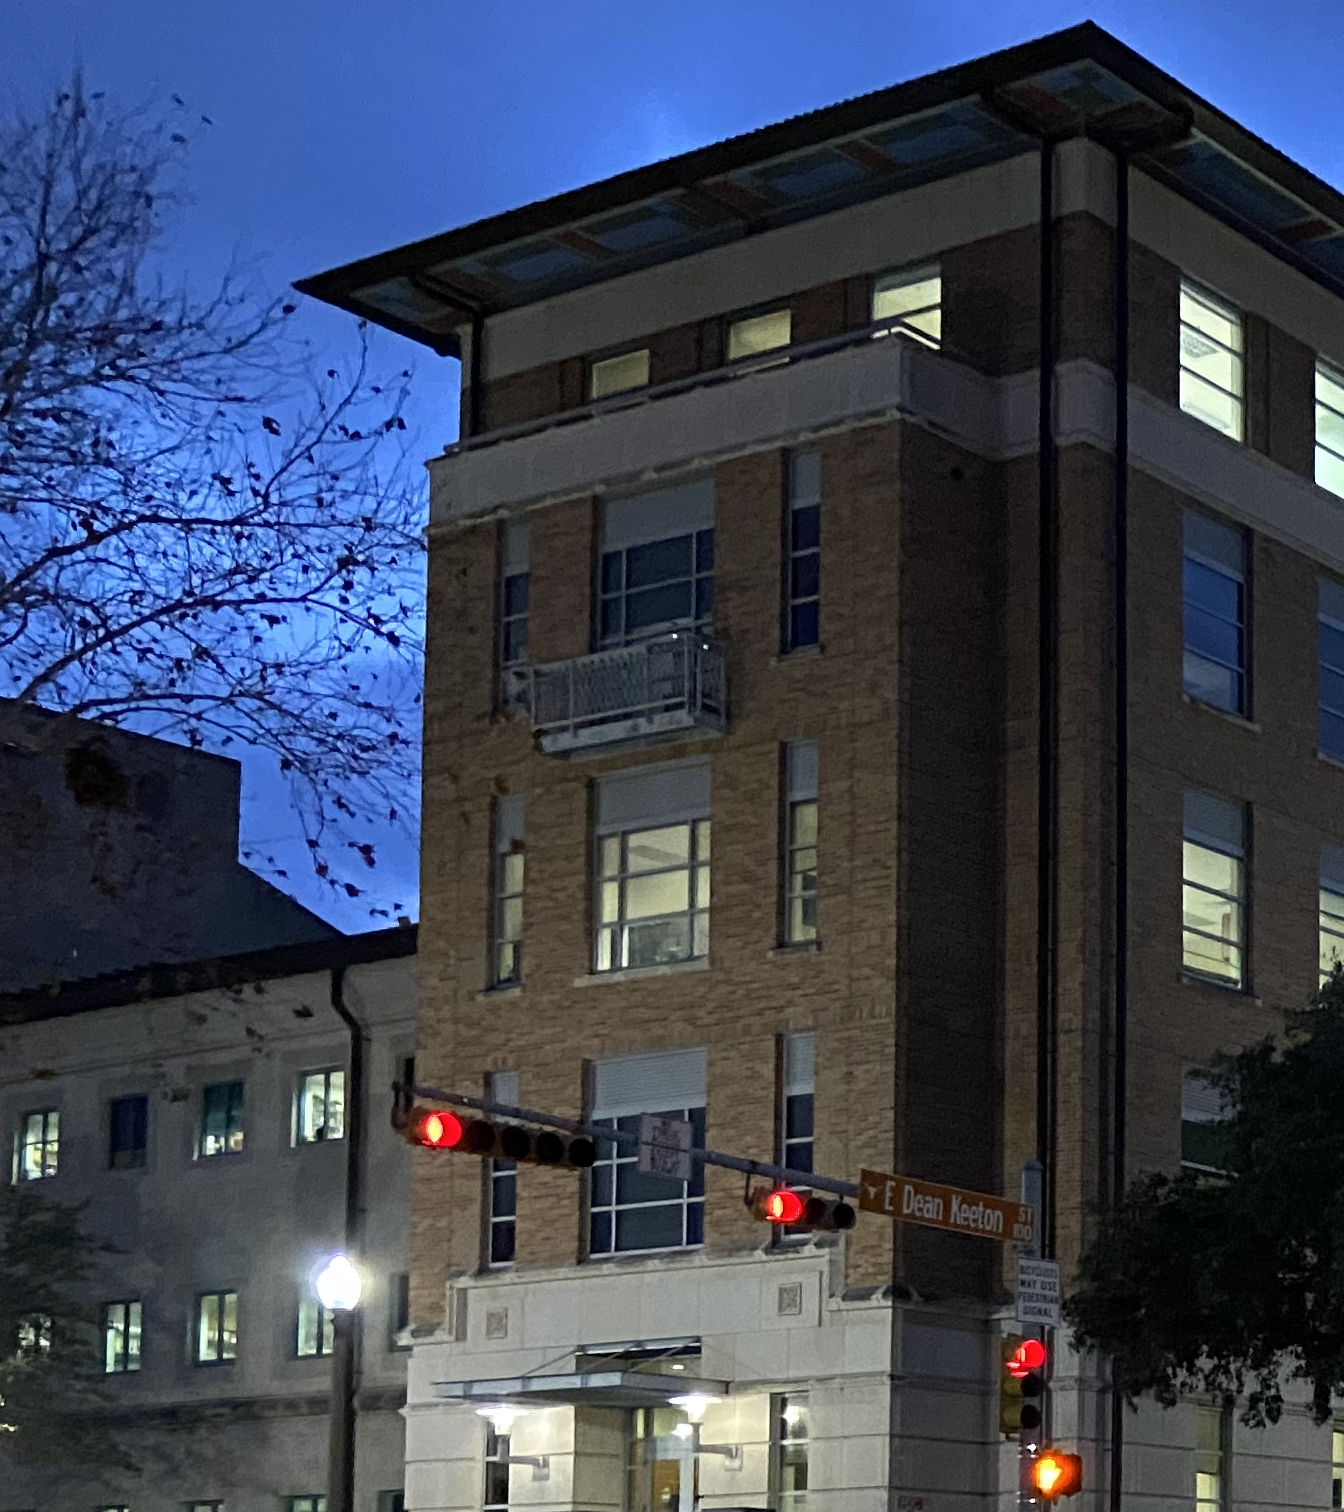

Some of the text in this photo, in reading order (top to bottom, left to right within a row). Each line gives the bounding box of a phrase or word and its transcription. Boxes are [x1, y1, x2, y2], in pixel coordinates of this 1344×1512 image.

[884, 1180, 1003, 1233] E Dean Keeton
[1018, 1207, 1034, 1224] ST
[1013, 1223, 1032, 1241] 100
[1020, 1279, 1057, 1292] MAY USE
